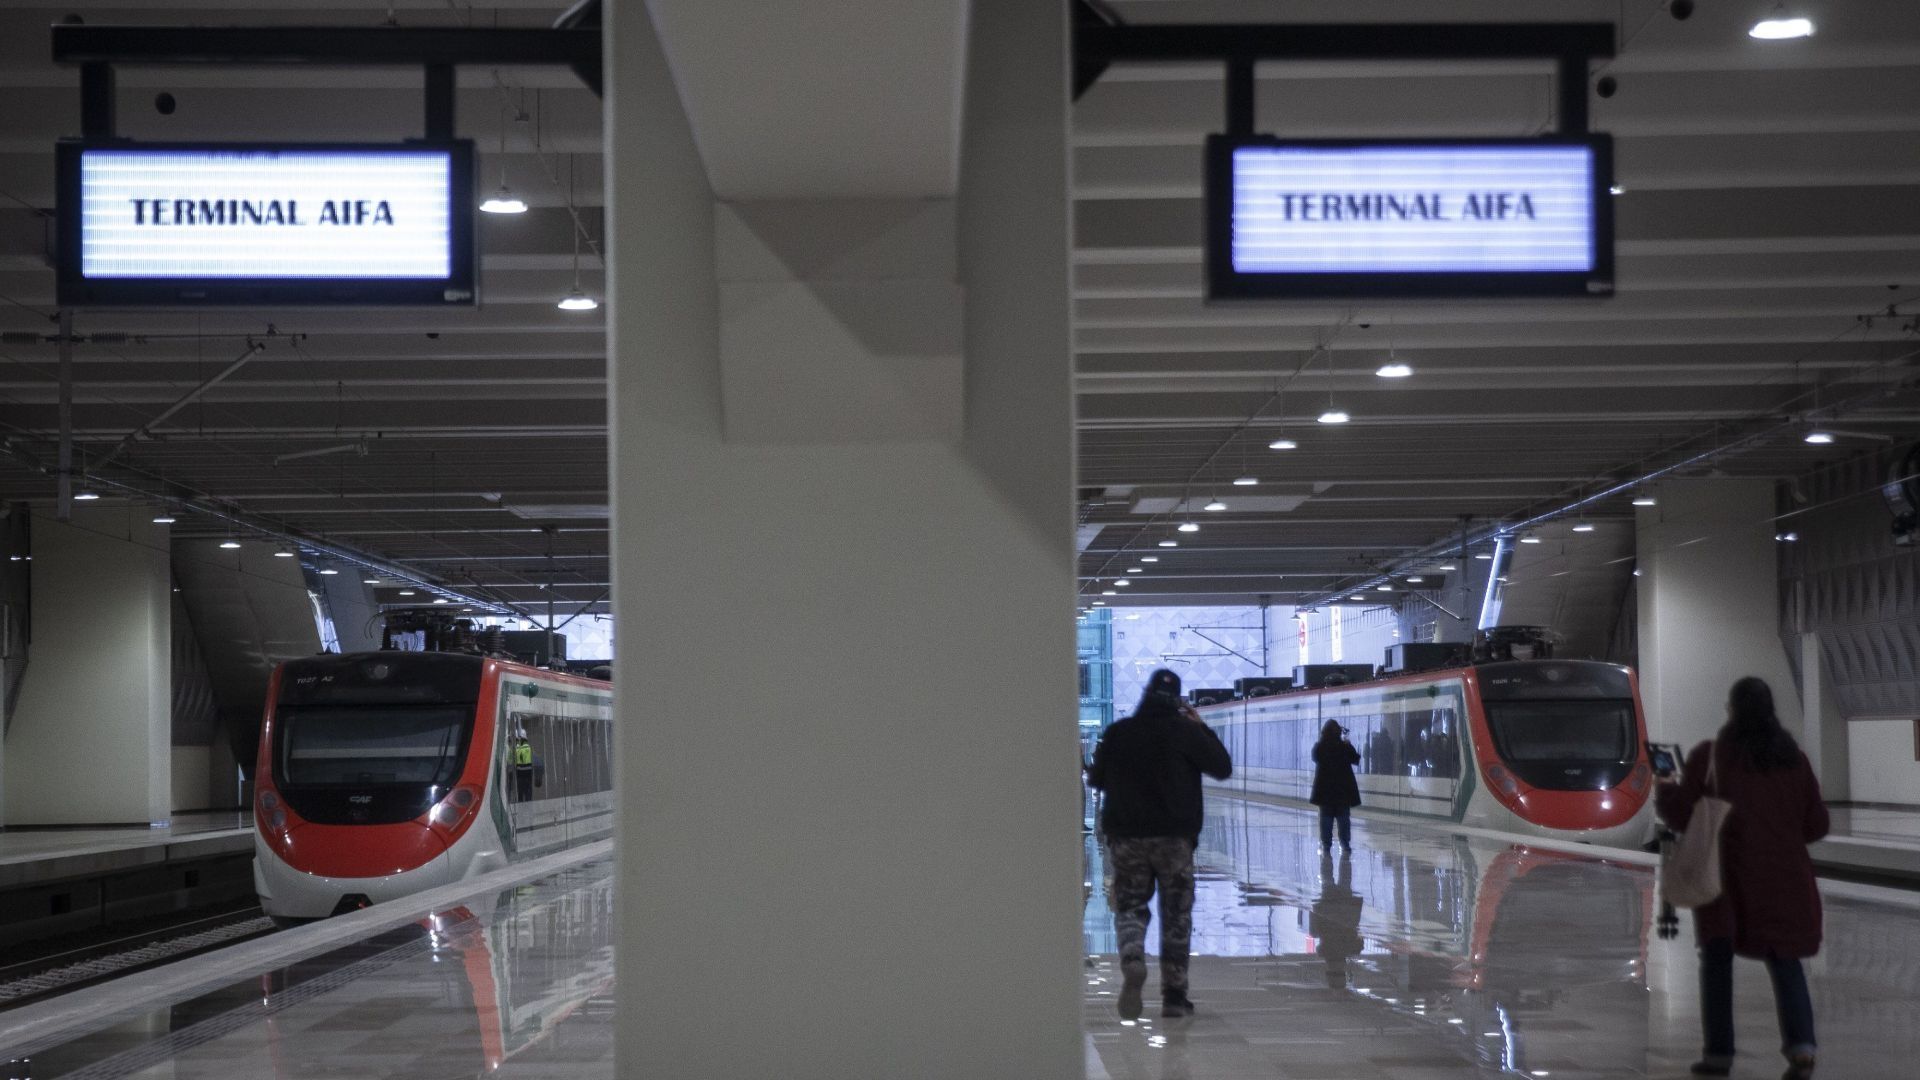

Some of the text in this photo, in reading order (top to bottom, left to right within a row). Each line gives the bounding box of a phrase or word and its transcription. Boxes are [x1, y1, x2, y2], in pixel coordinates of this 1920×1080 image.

[130, 198, 394, 226] TERMINAL AIFA
[1280, 193, 1536, 221] TERMINAL AIFA
